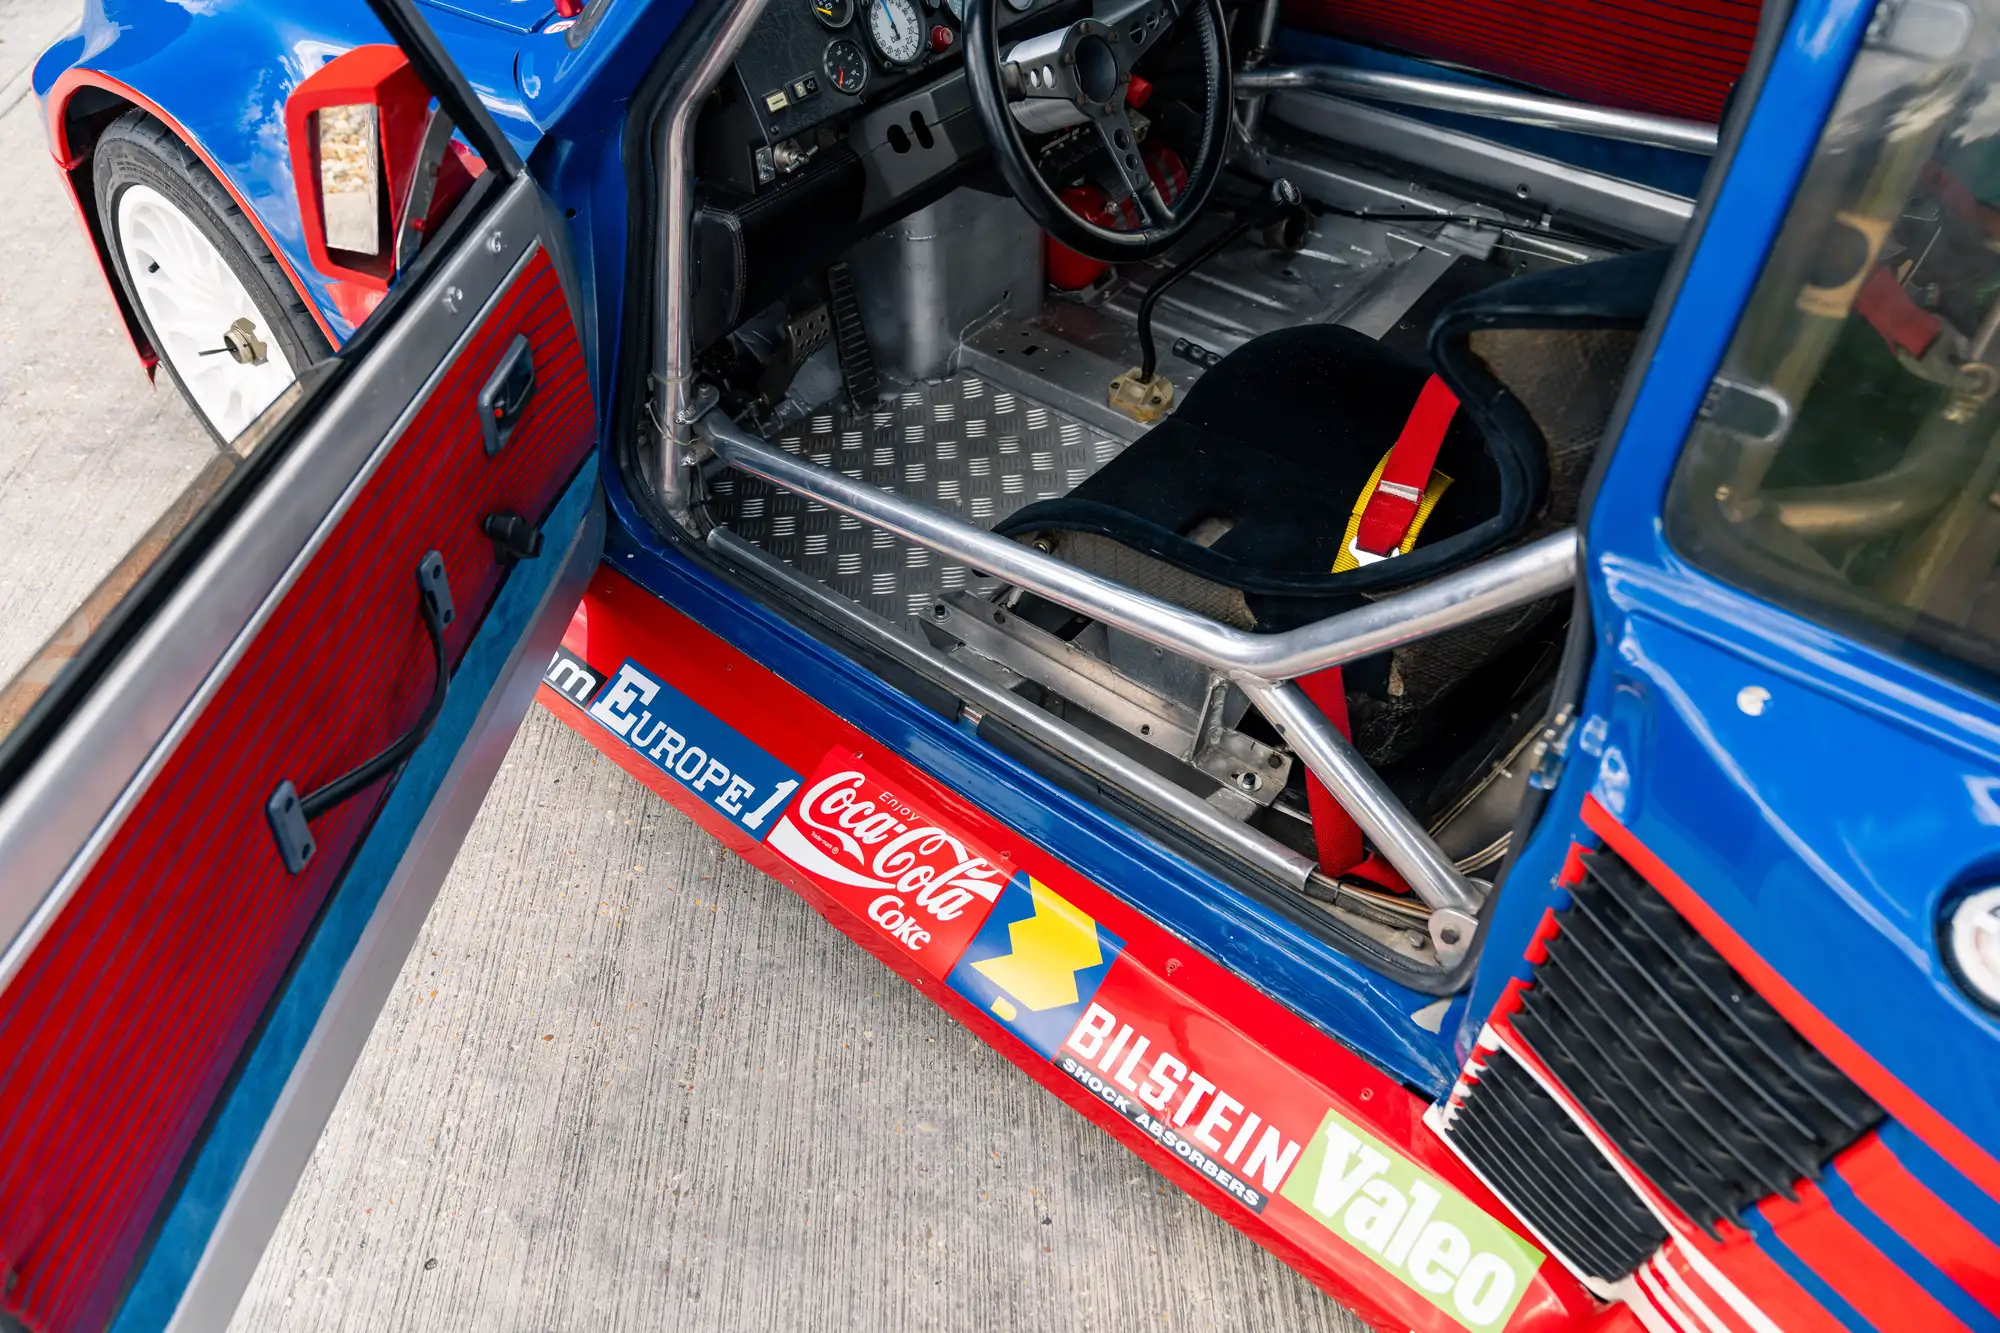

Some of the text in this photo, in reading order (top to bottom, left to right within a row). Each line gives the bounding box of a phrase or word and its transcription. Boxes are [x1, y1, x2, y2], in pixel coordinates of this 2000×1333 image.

[799, 771, 1003, 921] Coca-Cola
[878, 790, 919, 820] Enjoy
[868, 895, 931, 951] Coke
[1062, 1057, 1260, 1206] SHOCK ABSORBERS
[1066, 1002, 1301, 1194] BILSTEIN
[1312, 1121, 1517, 1327] Valeo
